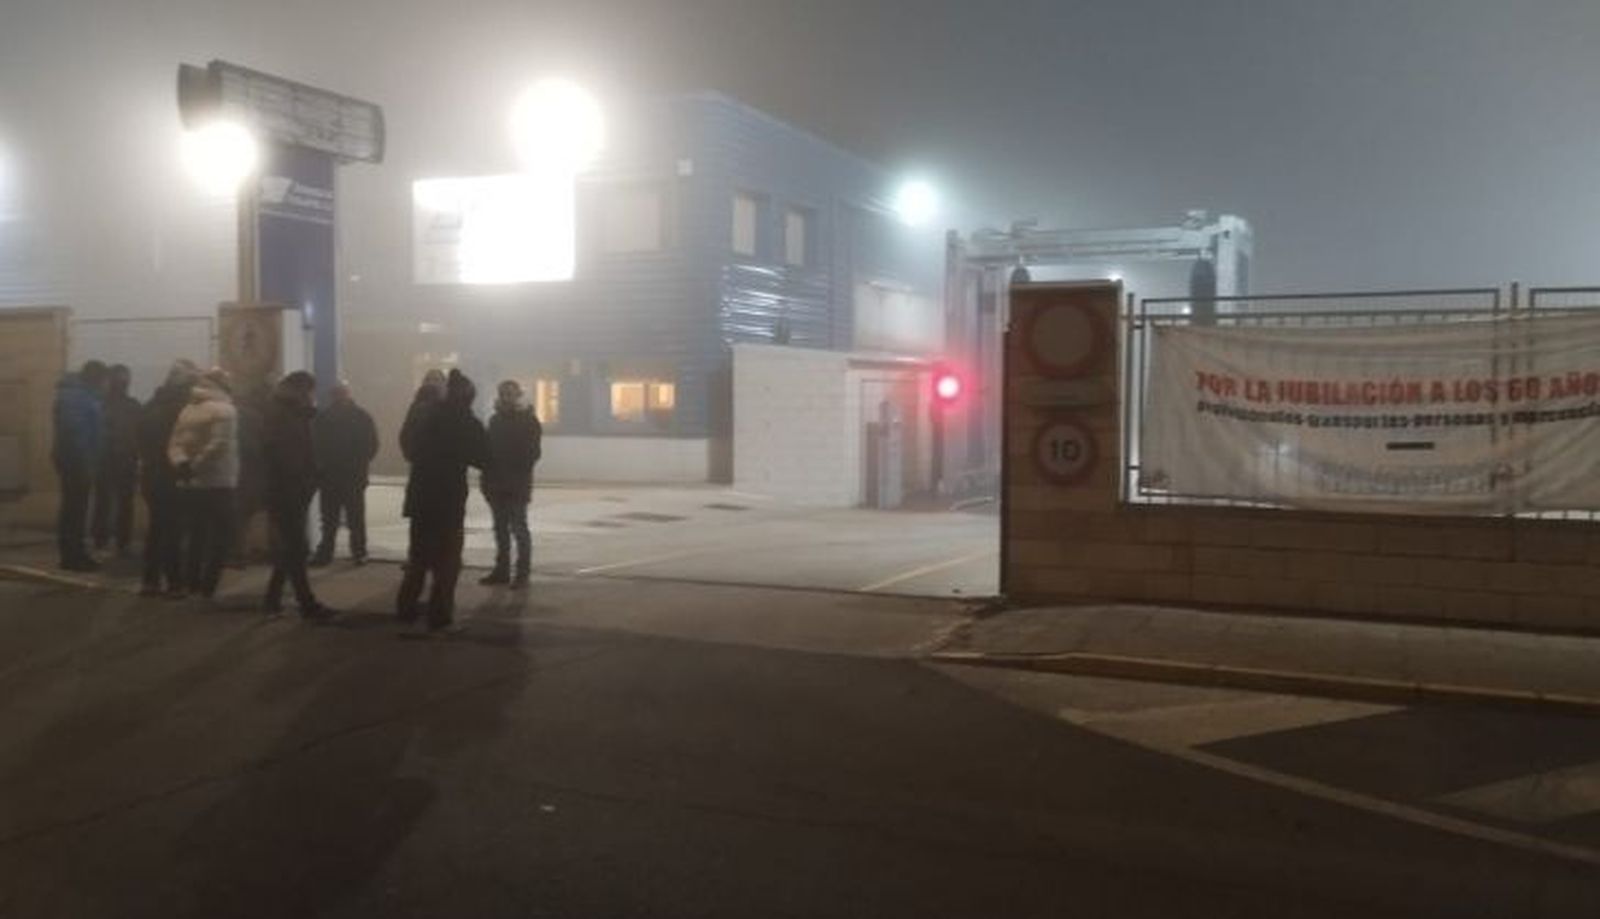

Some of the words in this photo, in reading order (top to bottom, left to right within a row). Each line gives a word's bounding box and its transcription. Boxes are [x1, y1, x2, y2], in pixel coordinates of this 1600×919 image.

[1246, 378, 1271, 403] LA
[1430, 379, 1446, 404] A
[1454, 378, 1499, 404] LOS
[1508, 375, 1541, 402] 60
[1050, 439, 1082, 462] 10
